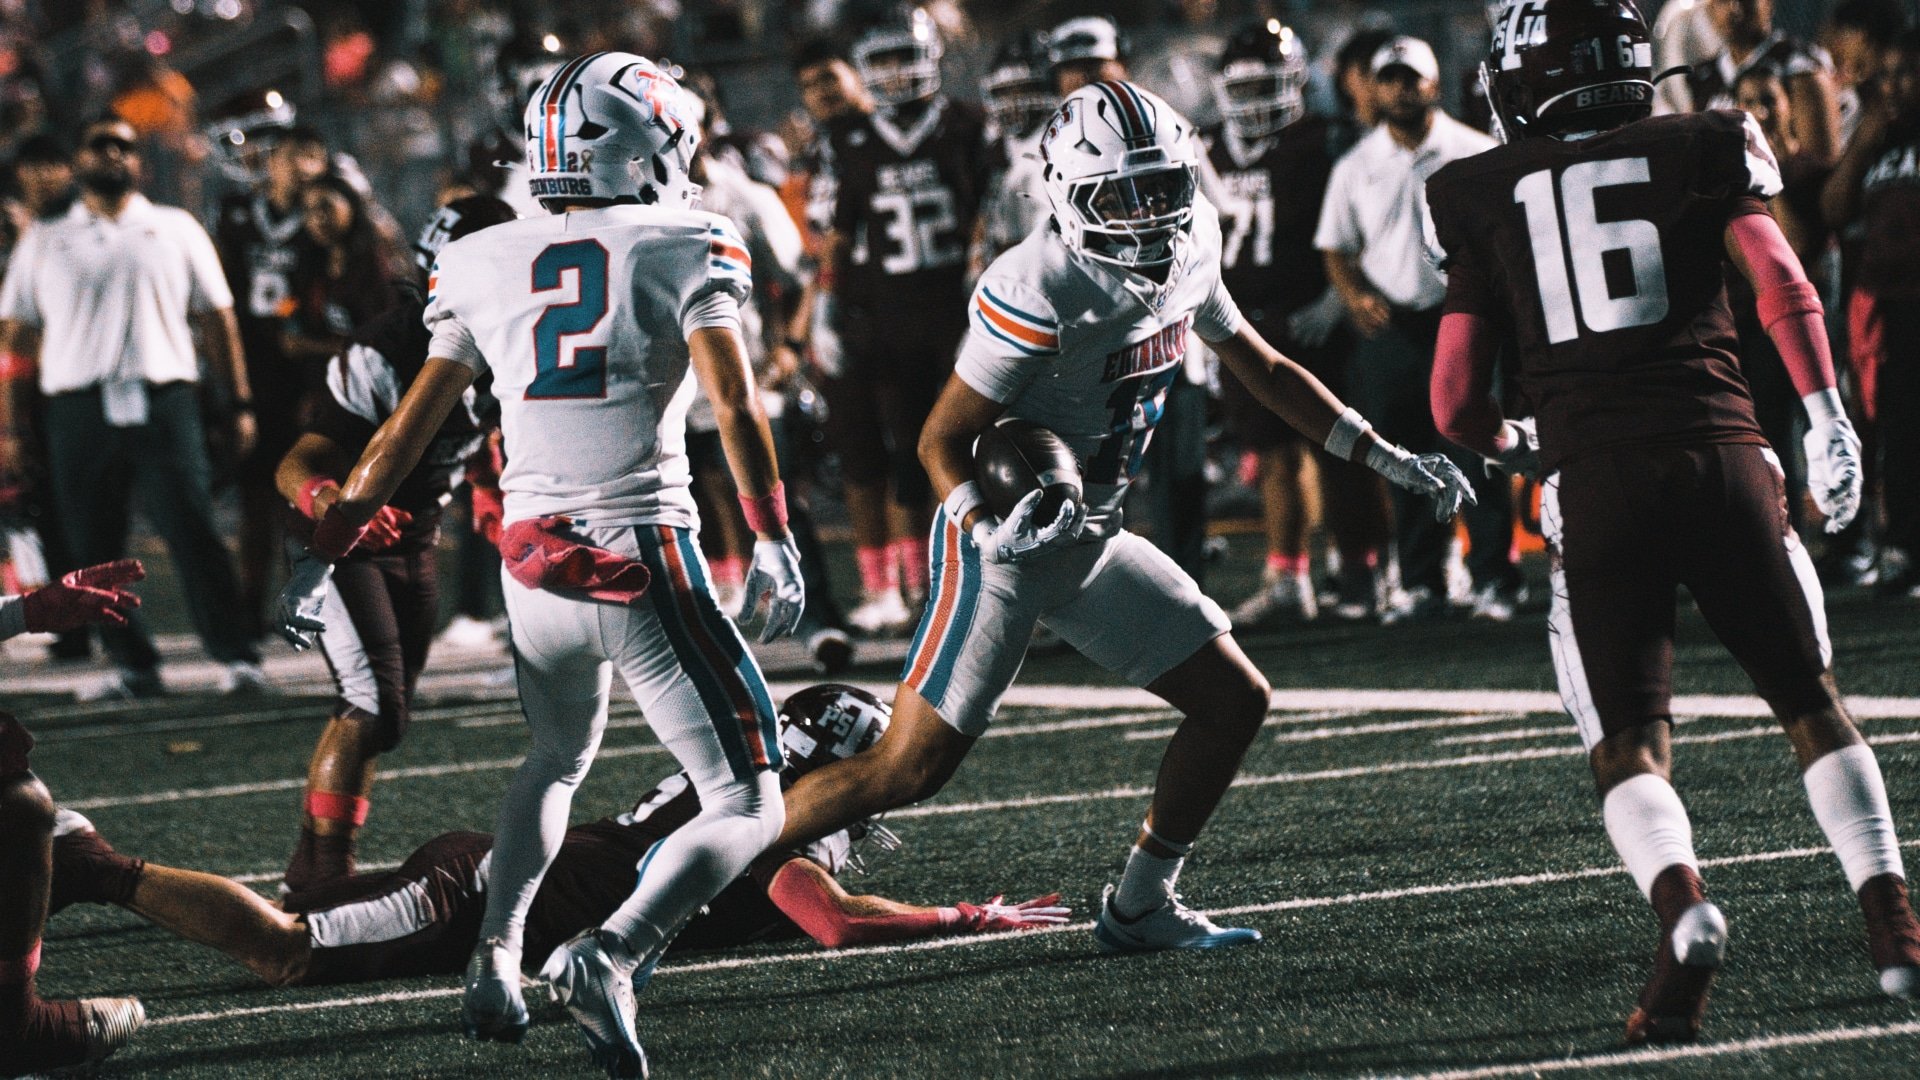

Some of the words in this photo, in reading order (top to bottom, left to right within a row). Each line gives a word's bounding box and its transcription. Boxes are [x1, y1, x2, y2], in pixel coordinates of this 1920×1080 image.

[1576, 84, 1646, 108] BEARS
[566, 151, 579, 173] 2
[870, 188, 964, 274] 32
[1219, 198, 1275, 269] 71
[1514, 156, 1670, 345] 16
[523, 238, 610, 401] 2
